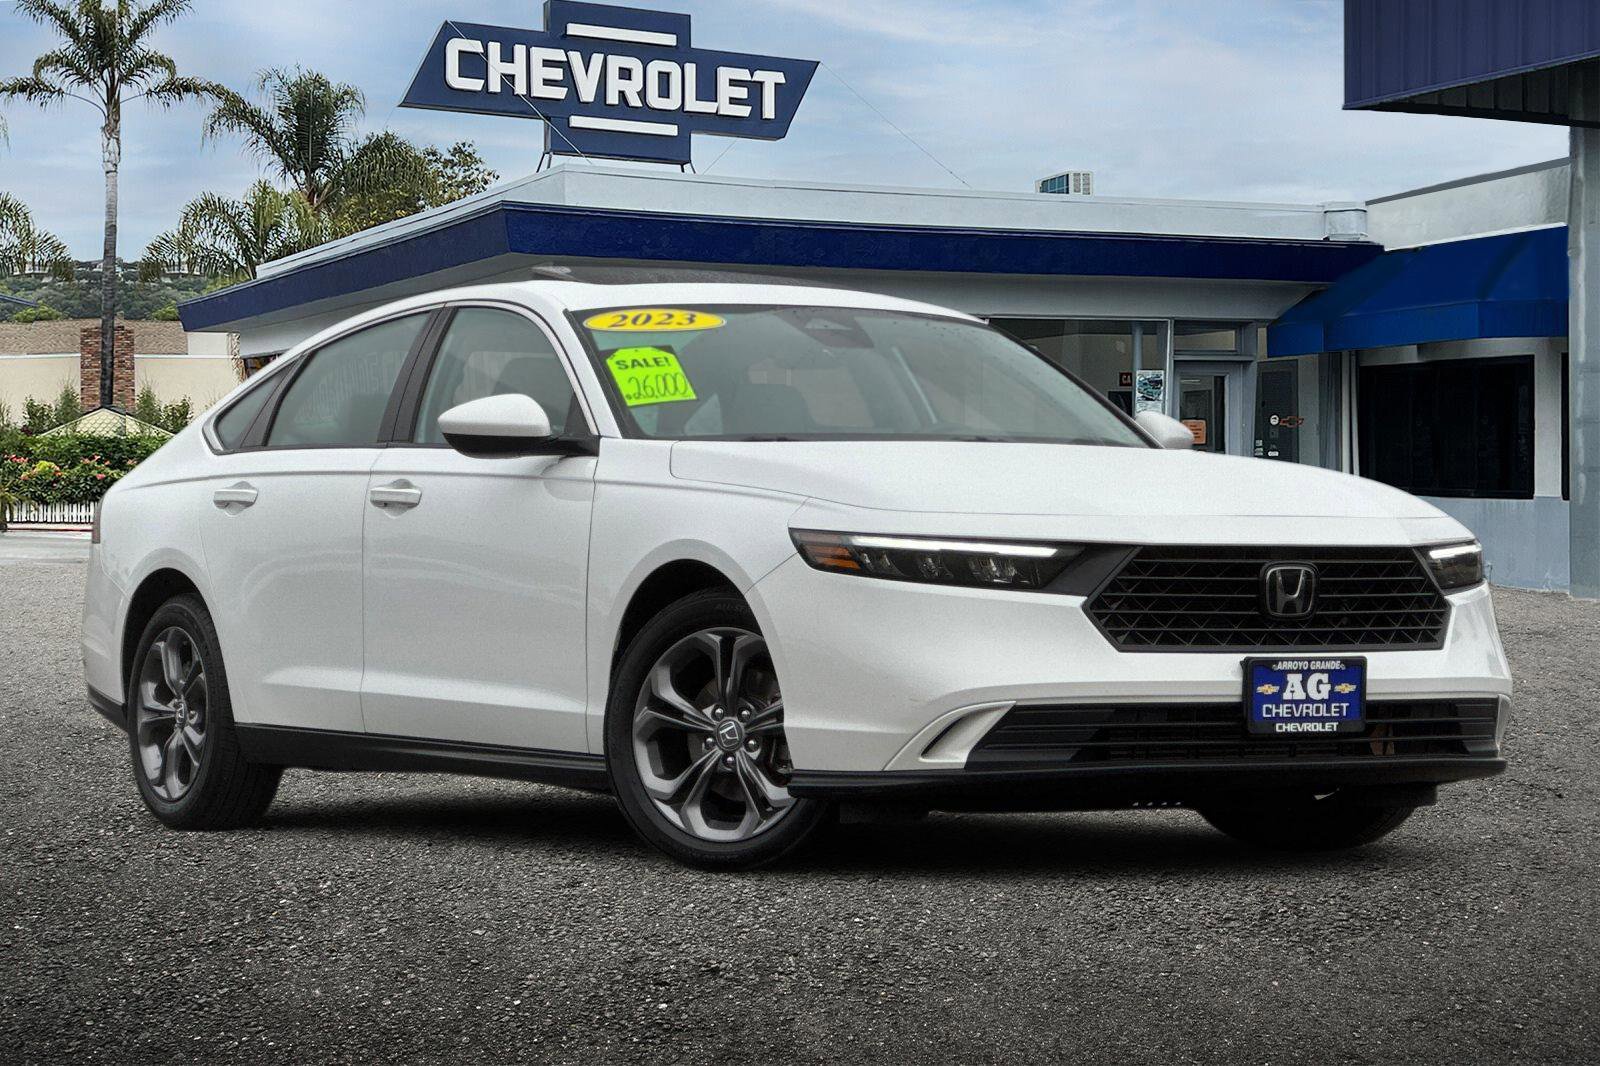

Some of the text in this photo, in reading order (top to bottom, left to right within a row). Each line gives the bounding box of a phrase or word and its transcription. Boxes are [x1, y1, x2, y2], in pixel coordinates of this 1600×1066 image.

[446, 37, 786, 120] CHEVROLET
[608, 313, 697, 328] 2023
[615, 356, 671, 370] SALE!
[1277, 661, 1341, 670] ARROYO GRANDE
[1283, 672, 1332, 700] AG
[1262, 703, 1350, 717] CHEVROLET
[1276, 722, 1339, 732] CHEVROLET
